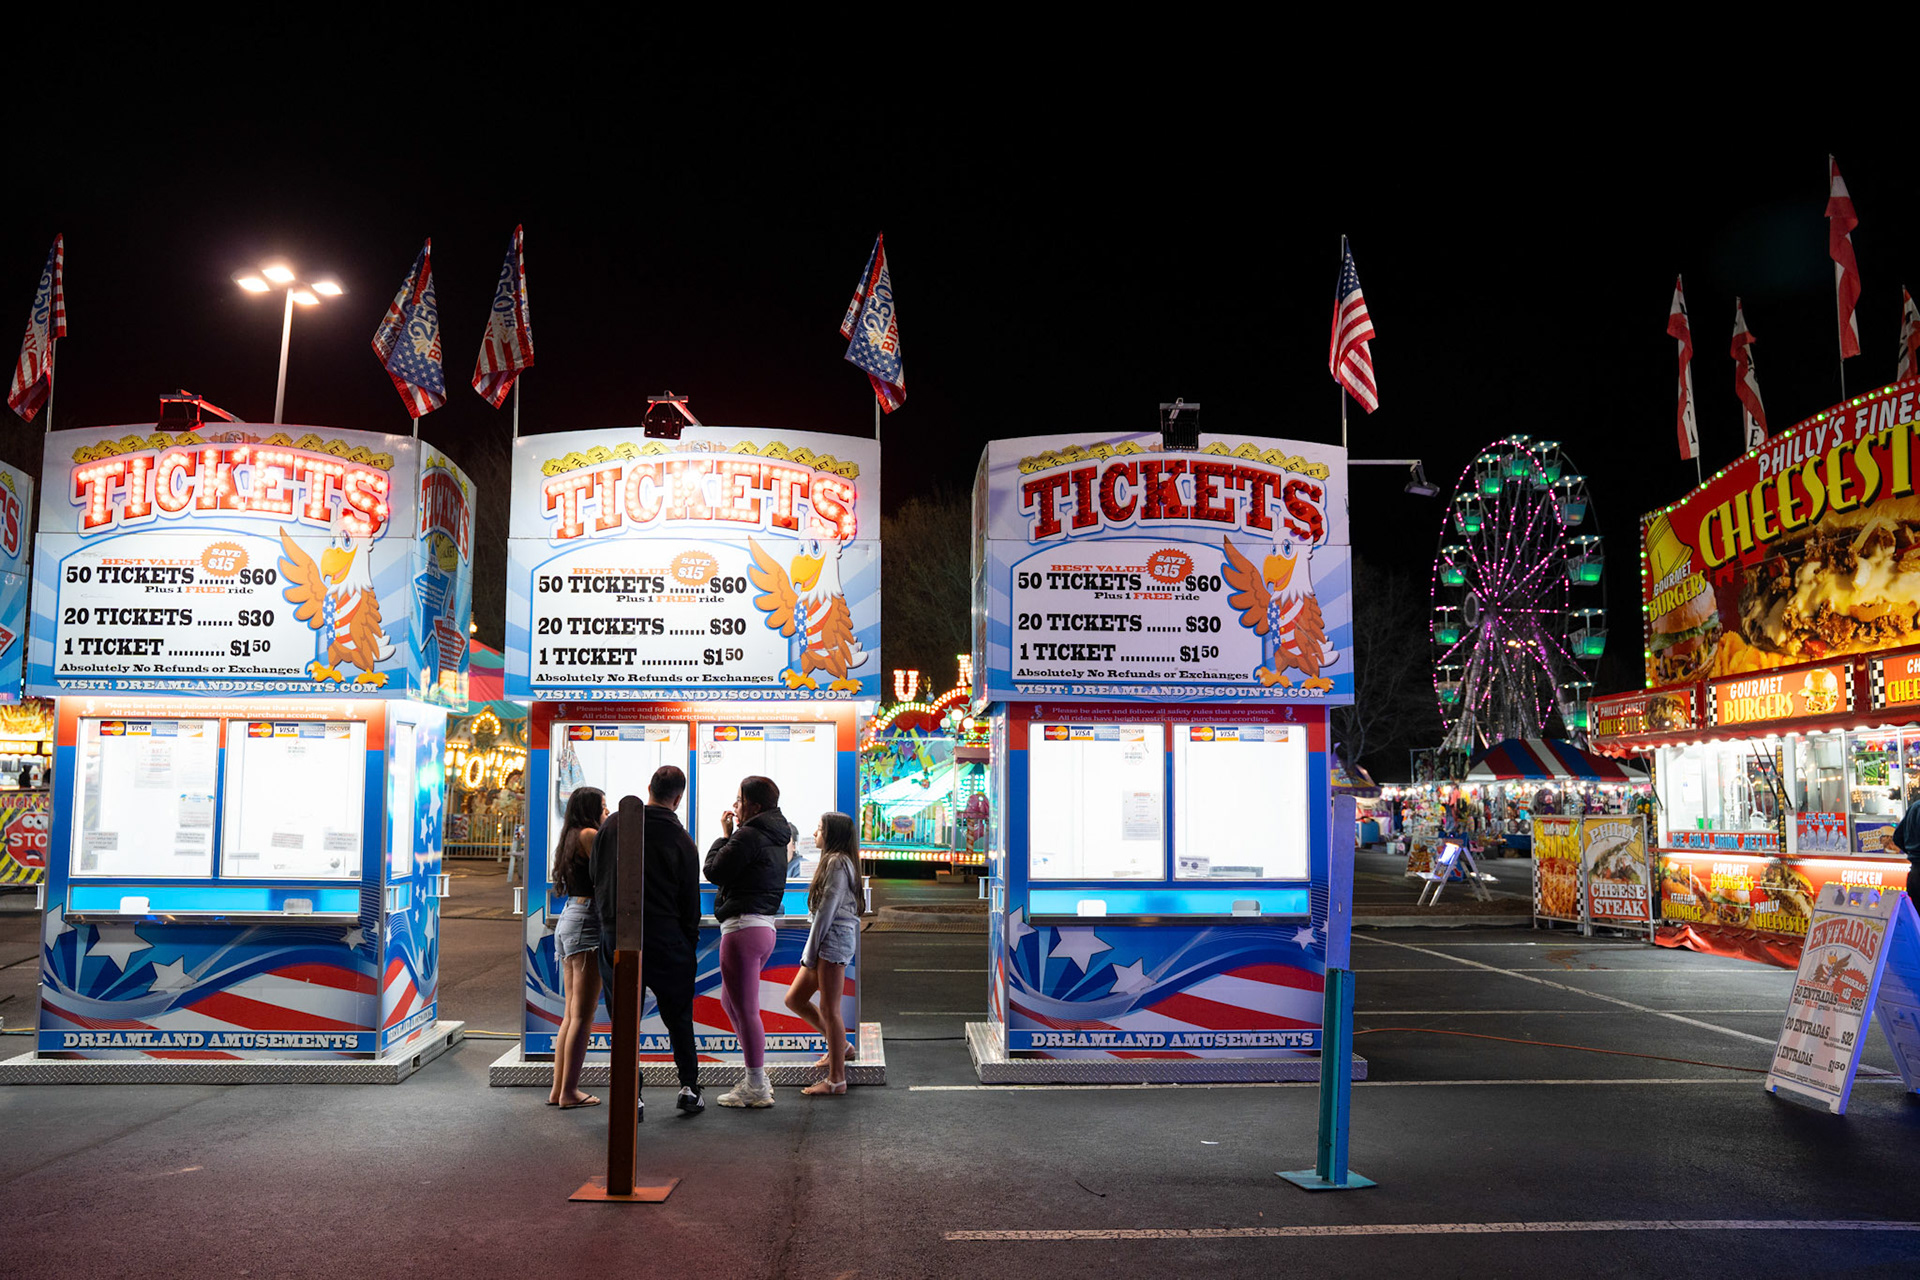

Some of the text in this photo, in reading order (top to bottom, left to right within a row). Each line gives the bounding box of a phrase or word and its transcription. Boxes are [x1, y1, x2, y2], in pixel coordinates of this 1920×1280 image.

[1757, 415, 1846, 482] PHILLY'S
[76, 444, 388, 538] TICKETS
[546, 459, 858, 540] TICKETS
[1024, 459, 1323, 541] TICKETS
[211, 548, 242, 558] SAVE
[1156, 555, 1186, 565] SAVE
[101, 558, 145, 566] BEST
[207, 557, 235, 571] $15
[680, 557, 711, 567] SAVE
[1050, 564, 1146, 573] BEST VALUE
[66, 566, 277, 585] 50 TICKETS $60
[572, 567, 616, 575] BEST
[677, 566, 704, 580] $15
[1153, 564, 1180, 578] $15
[1653, 560, 1692, 596] GOURMET
[144, 585, 174, 593] Plus
[185, 586, 226, 594] FREE
[228, 587, 254, 595] ride
[539, 575, 747, 594] 50 TICKETS $60
[1018, 572, 1221, 592] 50 TICKETS $60
[656, 595, 697, 603] FREE
[698, 595, 725, 603] ride
[1094, 591, 1200, 601] Plus 1 FREE ride
[1648, 569, 1708, 623] BURGERS
[64, 607, 275, 627] 20 TICKETS $30
[1018, 613, 1221, 633] 20 TICKETS $30
[538, 617, 747, 635] 20 TICKETS $30
[64, 637, 73, 655] 1
[78, 638, 164, 656] TICKET
[1020, 643, 1029, 660] 1
[1033, 643, 1116, 661] TICKET
[539, 647, 548, 665] 1
[552, 648, 637, 665] TICKET
[60, 663, 130, 674] Absolutely
[133, 664, 151, 672] No
[153, 664, 209, 673] Refunds
[228, 665, 300, 675] Exchanges
[1017, 668, 1085, 679] Absolutely
[1087, 669, 1105, 678] No
[1107, 669, 1162, 679] Refunds
[1178, 670, 1249, 680] Exchanges
[57, 679, 378, 693] VISIT: DREAMLANDDISCOUNTS.COM
[536, 673, 605, 683] Absolutely
[607, 673, 625, 682] No
[627, 673, 683, 682] Refunds
[702, 674, 774, 683] Exchanges
[533, 689, 852, 701] VISIT: DREAMLANDDISCOUNTS.COM
[1014, 684, 1325, 698] VISIT: DREAMLANDDISCOUNTS.COM
[1730, 676, 1784, 700] GOURMET
[1112, 707, 1127, 715] and
[1129, 707, 1153, 715] follow
[1167, 708, 1191, 716] safety
[1214, 708, 1231, 716] that
[1232, 708, 1245, 716] are
[1247, 709, 1276, 717] posted.
[1723, 692, 1794, 724] BURGERS
[1114, 715, 1140, 723] height
[1141, 715, 1189, 723] restrictions,
[1190, 715, 1228, 723] purchase
[279, 726, 296, 734] VISA
[1588, 822, 1639, 845] PHILLY
[1689, 834, 1710, 849] COLD
[1714, 834, 1739, 849] DRINK
[1713, 862, 1749, 877] GOURMET
[1841, 869, 1883, 885] CHICKEN
[1710, 872, 1755, 892] BURGERS
[1590, 883, 1647, 899] CHEESE
[1593, 899, 1646, 917] STEAK
[1664, 901, 1704, 922] SAUSAGE
[1754, 900, 1780, 914] PHILLY
[1807, 919, 1879, 961] ENTRADAS
[1803, 987, 1839, 1006] ENTRADAS
[1793, 1018, 1831, 1040] ENTRADAS
[63, 1033, 359, 1049] DREAMLAND AMUSEMENTS
[1031, 1032, 1314, 1048] DREAMLAND AMUSEMENTS
[1780, 1047, 1814, 1066] ENTRADAS
